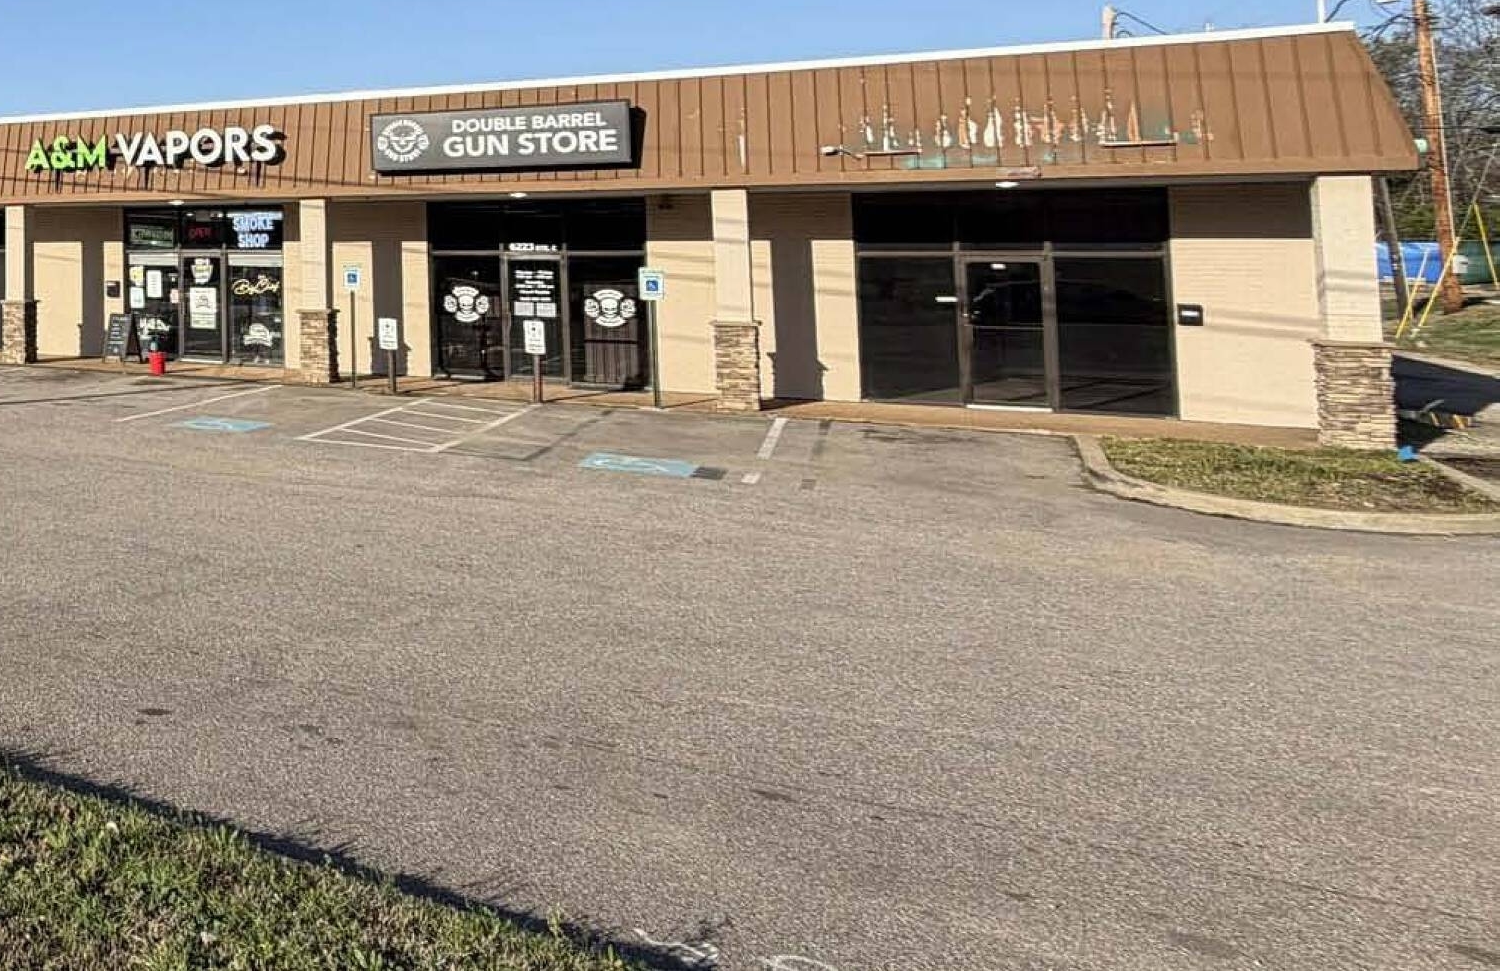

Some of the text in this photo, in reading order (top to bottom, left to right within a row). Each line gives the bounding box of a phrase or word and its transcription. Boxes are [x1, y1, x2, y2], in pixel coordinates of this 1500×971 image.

[451, 111, 608, 133] DOUBLE BARREL
[24, 124, 278, 171] A&M VAPORS
[442, 128, 618, 158] GUN STORE
[232, 214, 275, 232] SMOKE
[237, 233, 270, 248] SHOP
